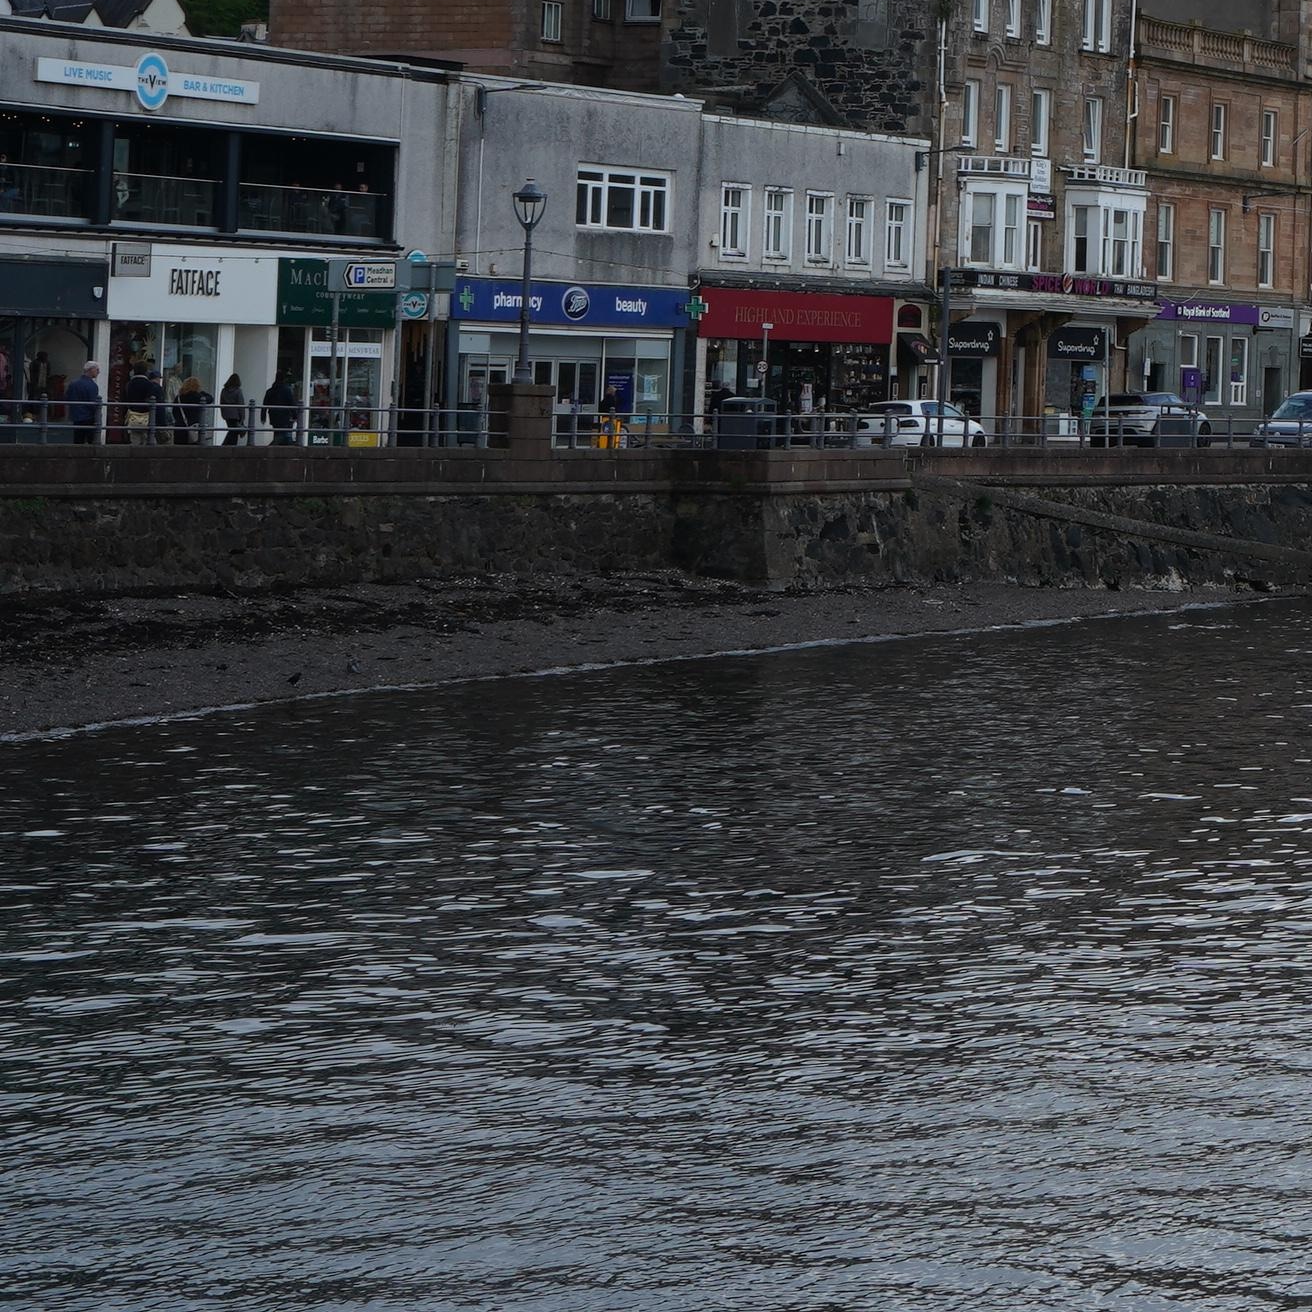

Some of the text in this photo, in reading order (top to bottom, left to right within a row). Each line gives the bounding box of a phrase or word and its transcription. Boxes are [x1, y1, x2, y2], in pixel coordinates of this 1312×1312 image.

[64, 67, 112, 81] LIVE MUSIC
[148, 75, 167, 88] VIEW
[183, 80, 244, 96] BAR & KITCHEN
[121, 255, 145, 265] FATFACE
[367, 266, 393, 275] Meadhan
[170, 268, 221, 296] FATFACE
[1032, 275, 1060, 291] SPICE
[316, 291, 366, 302] counrywear
[494, 292, 542, 311] pharmcy
[615, 297, 647, 316] beauty
[735, 306, 862, 327] HIGHLAND EXPERIENCE
[949, 338, 989, 352] Superdrug
[1057, 341, 1096, 355] Superdrug
[758, 362, 767, 371] 20
